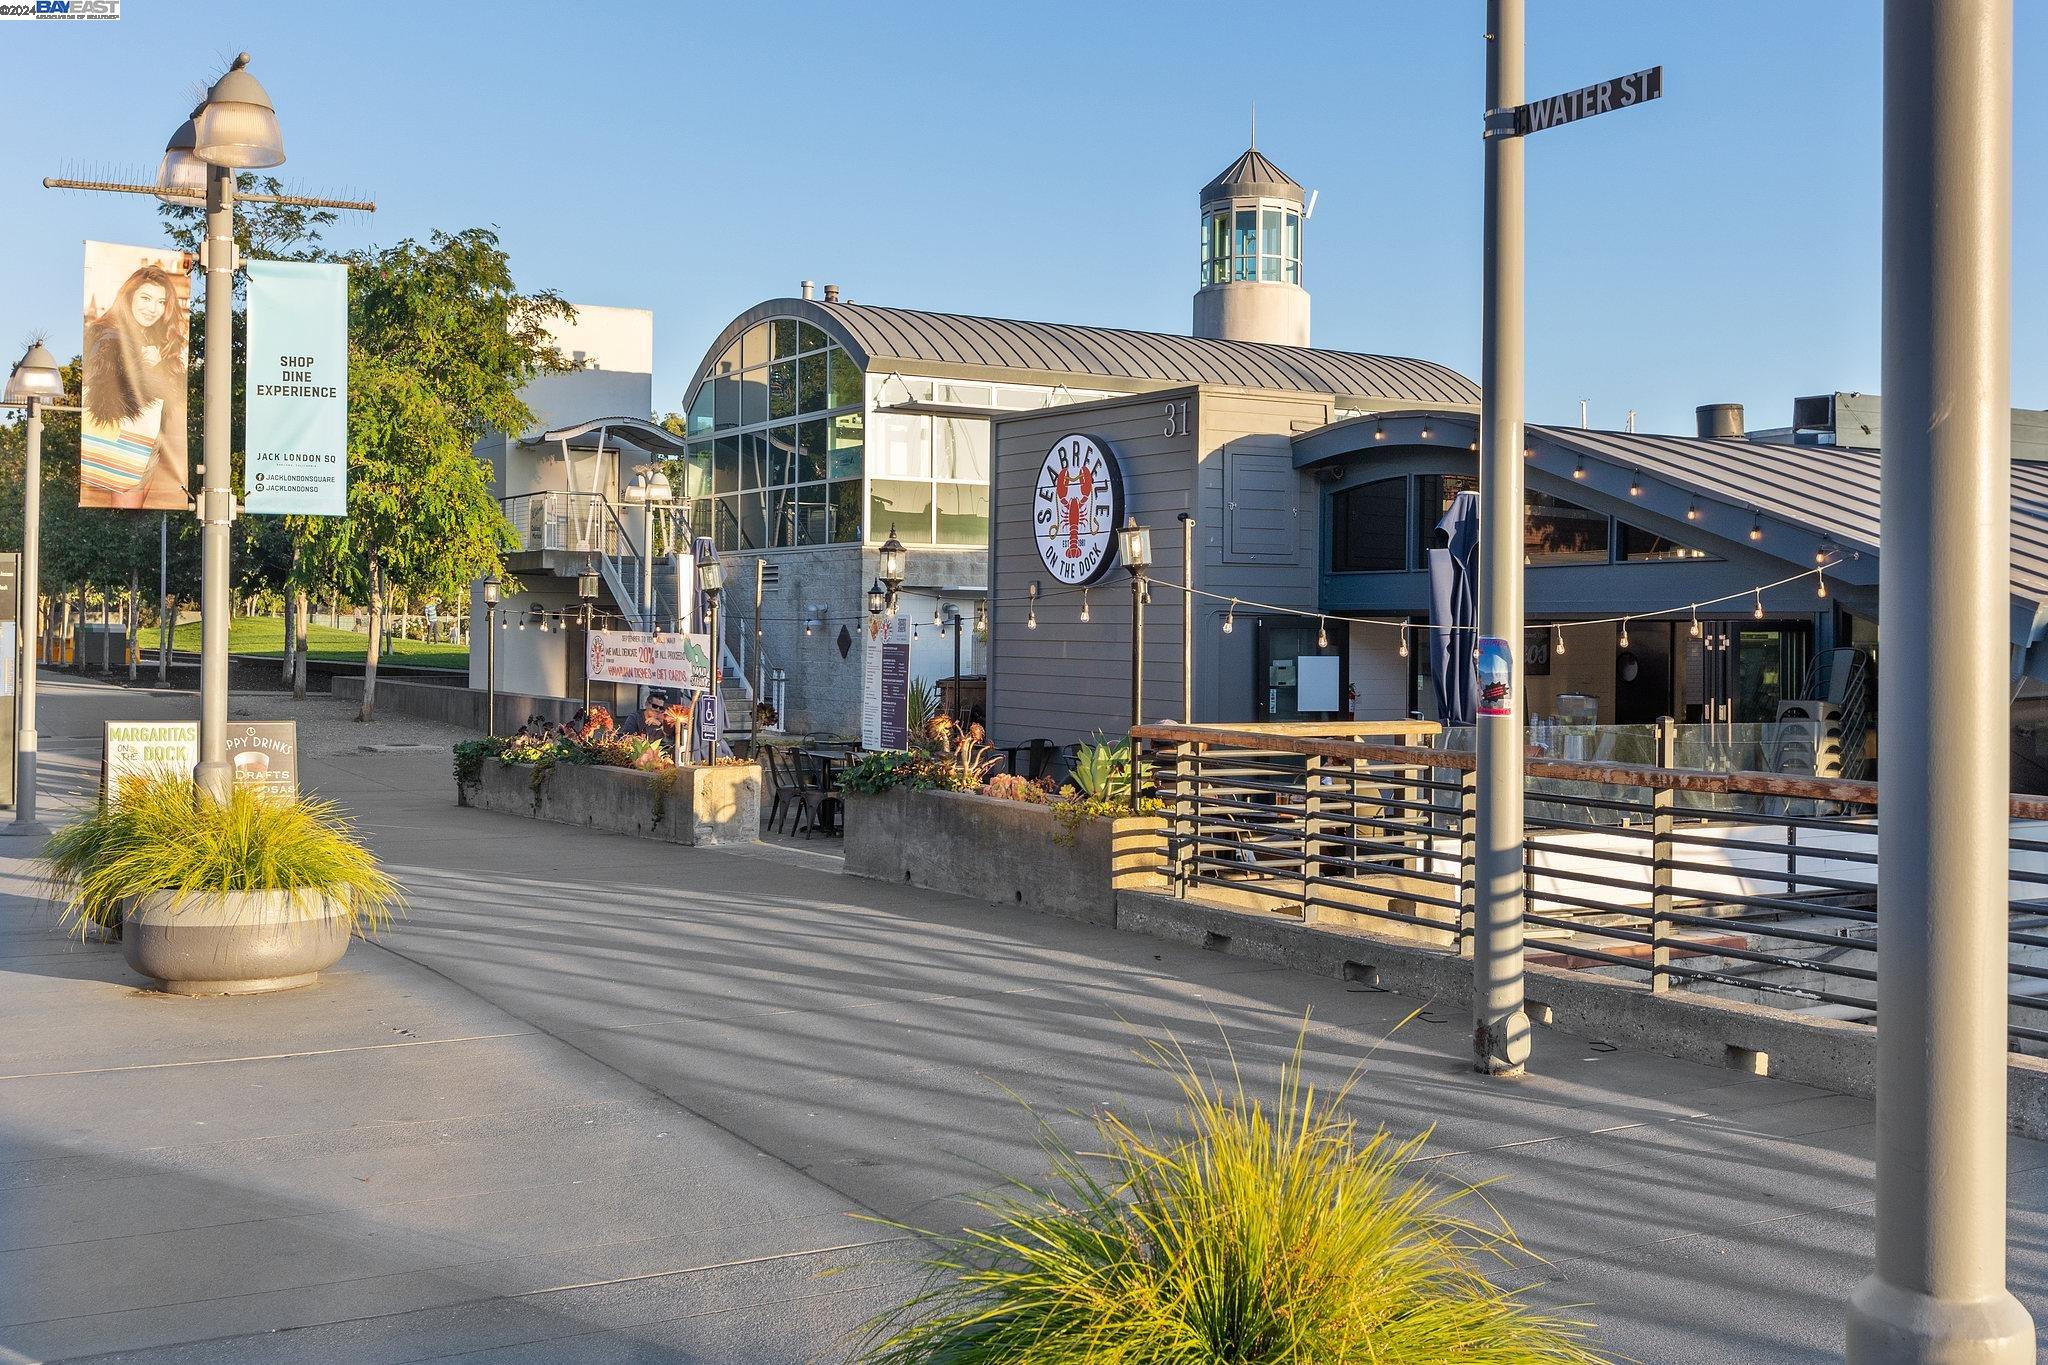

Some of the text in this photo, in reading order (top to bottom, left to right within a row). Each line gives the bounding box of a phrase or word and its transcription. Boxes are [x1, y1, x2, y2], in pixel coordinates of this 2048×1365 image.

[1529, 68, 1660, 132] WATER ST.
[280, 356, 314, 367] SHOP
[282, 371, 312, 382] DINE
[257, 385, 337, 398] EXPERIENCE
[1164, 401, 1190, 437] 31
[284, 453, 321, 462] LONDON
[324, 455, 336, 463] SQ
[266, 475, 335, 483] JACKLONDONSQUARE
[266, 485, 319, 493] JACKLONDONSQ
[1045, 543, 1102, 579] ON THE DOCK
[605, 647, 612, 656] WE
[612, 648, 621, 656] WILL
[639, 646, 655, 664] 20%
[608, 666, 634, 678] HAWAIIAN
[668, 670, 687, 682] CARDS
[110, 727, 196, 741] MARGARITAS
[117, 744, 129, 752] ON
[226, 737, 292, 755] PPY DRINKS
[143, 746, 187, 761] DOCK
[235, 770, 290, 780] DRAFTS
